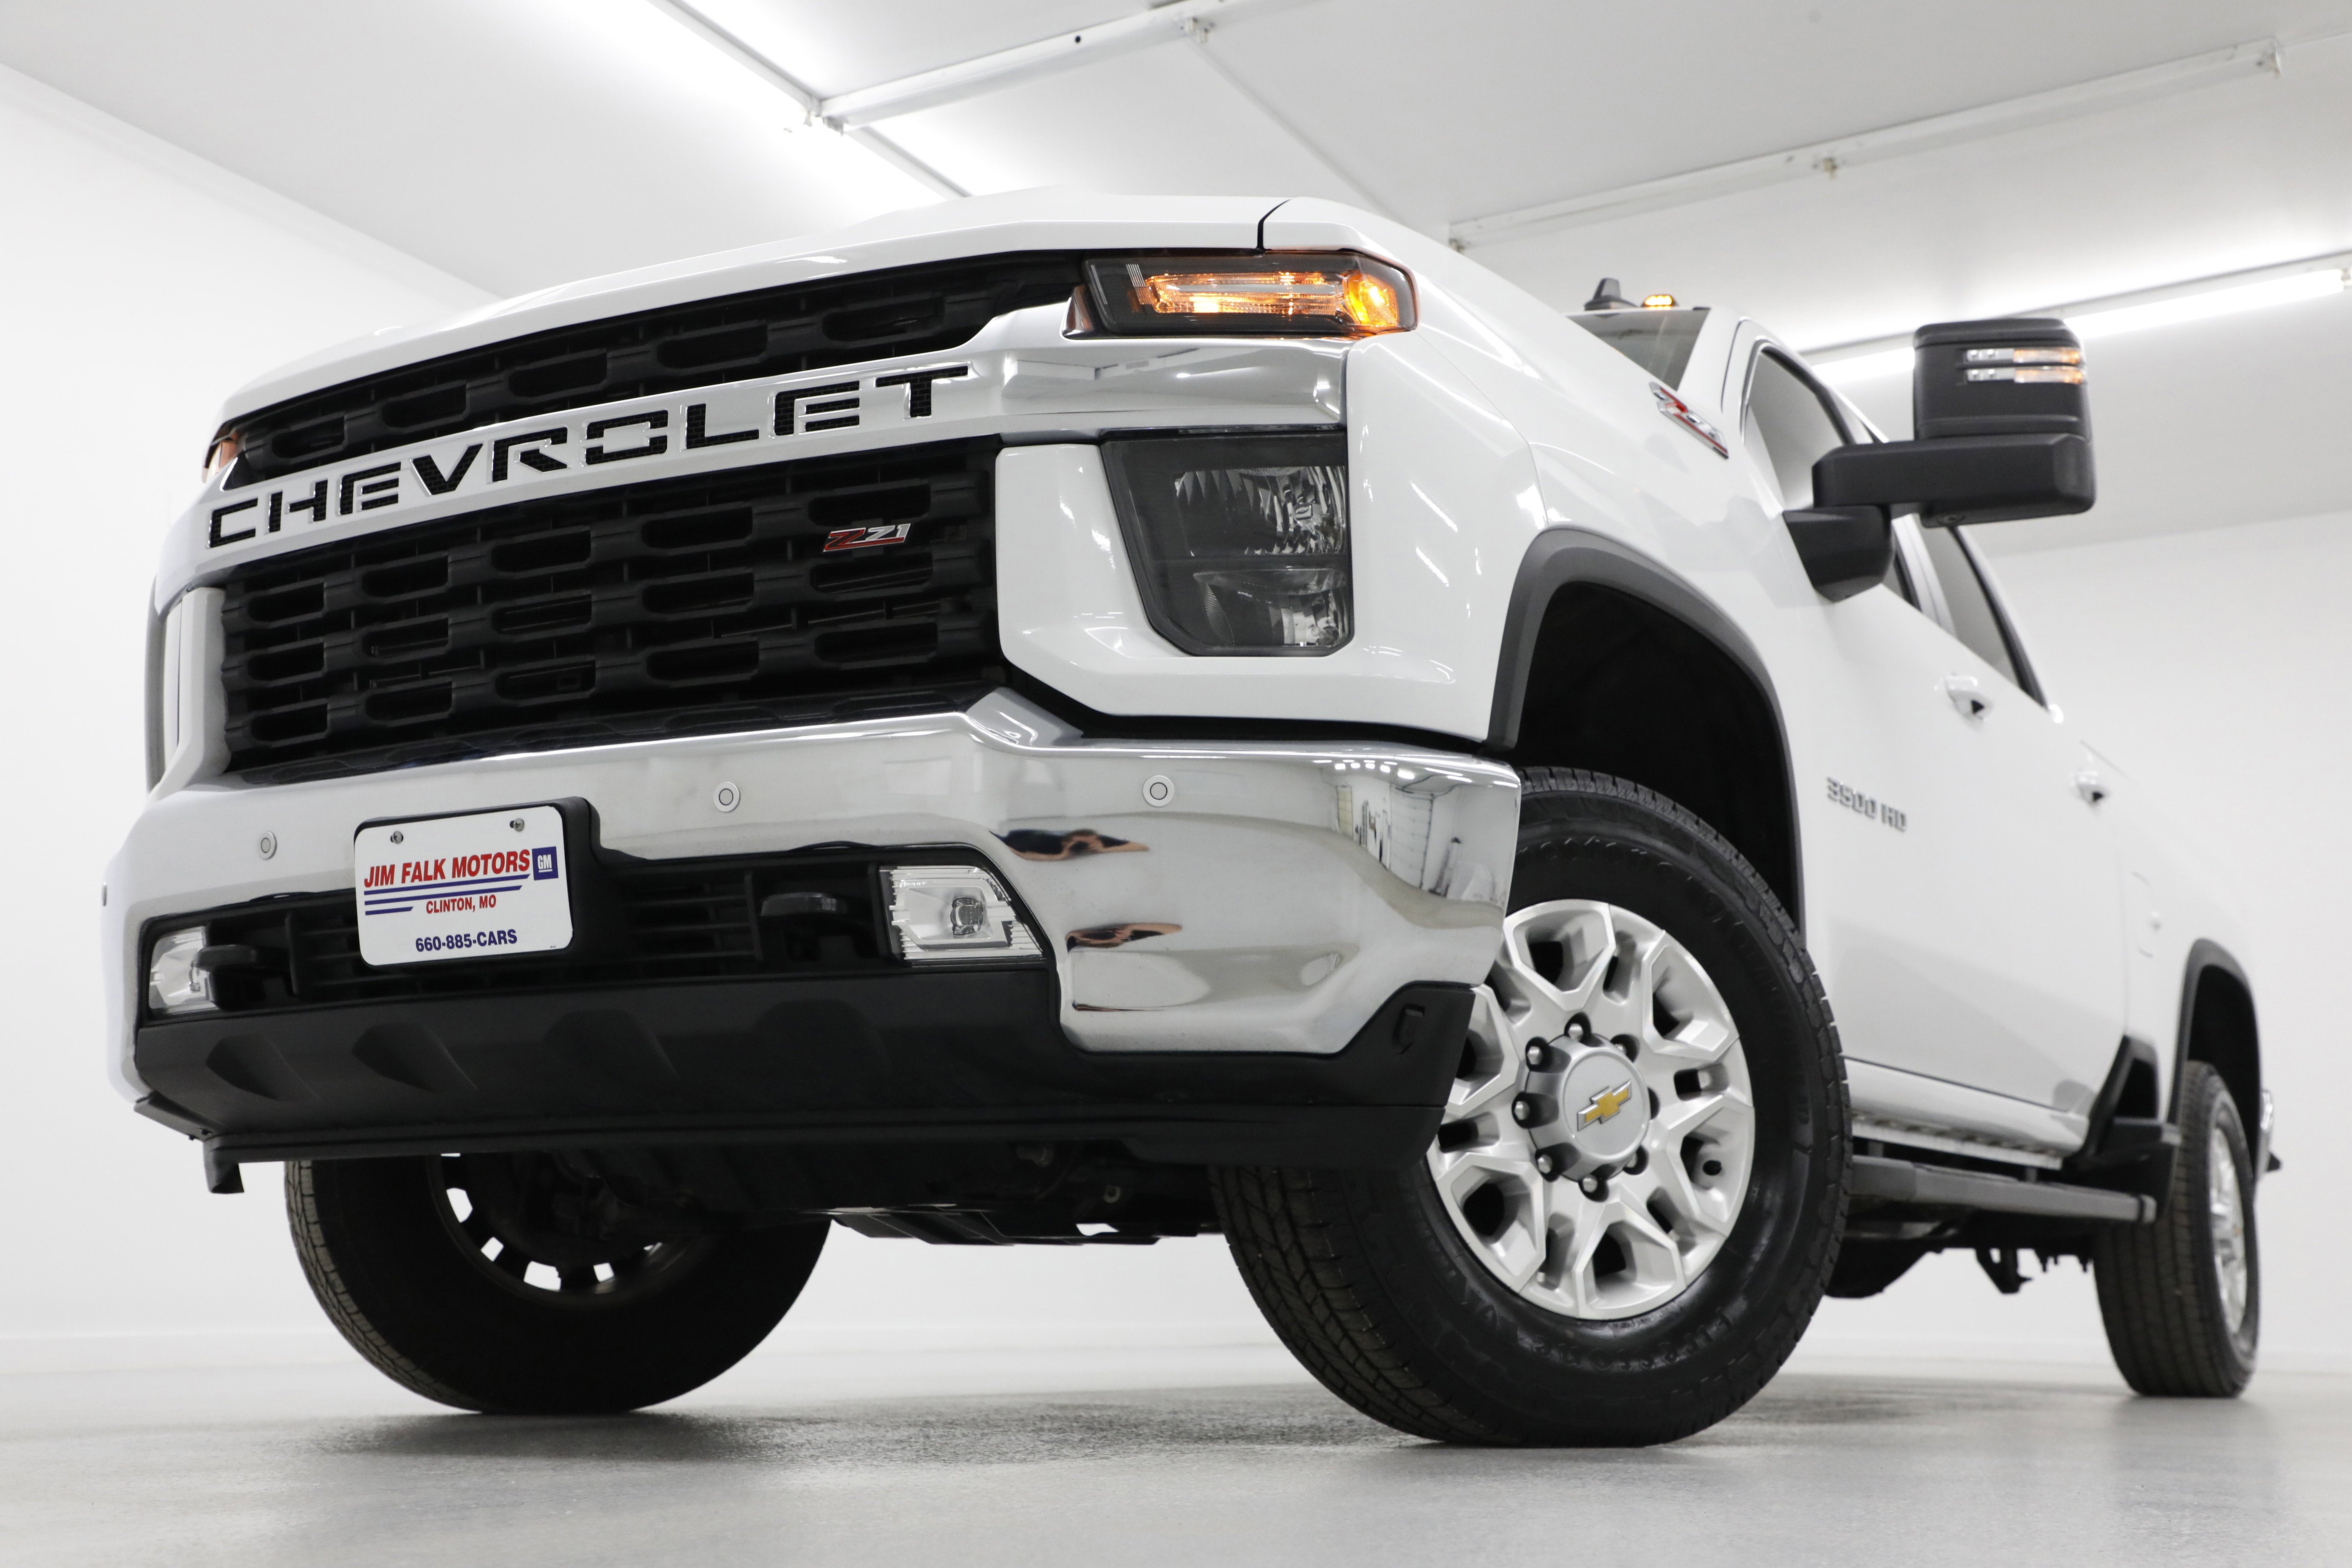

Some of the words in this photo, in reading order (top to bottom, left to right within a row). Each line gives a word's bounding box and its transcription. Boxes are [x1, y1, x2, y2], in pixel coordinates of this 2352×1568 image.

[207, 365, 969, 549] CHEVROLET
[823, 523, 911, 552] Z71
[364, 864, 395, 888] JIM
[401, 858, 446, 884] FALK
[452, 849, 530, 878] MOTORS
[537, 854, 552, 870] GM
[426, 897, 475, 914] CLINTON,
[479, 895, 497, 908] MO
[416, 929, 517, 952] 660-885-CARS
